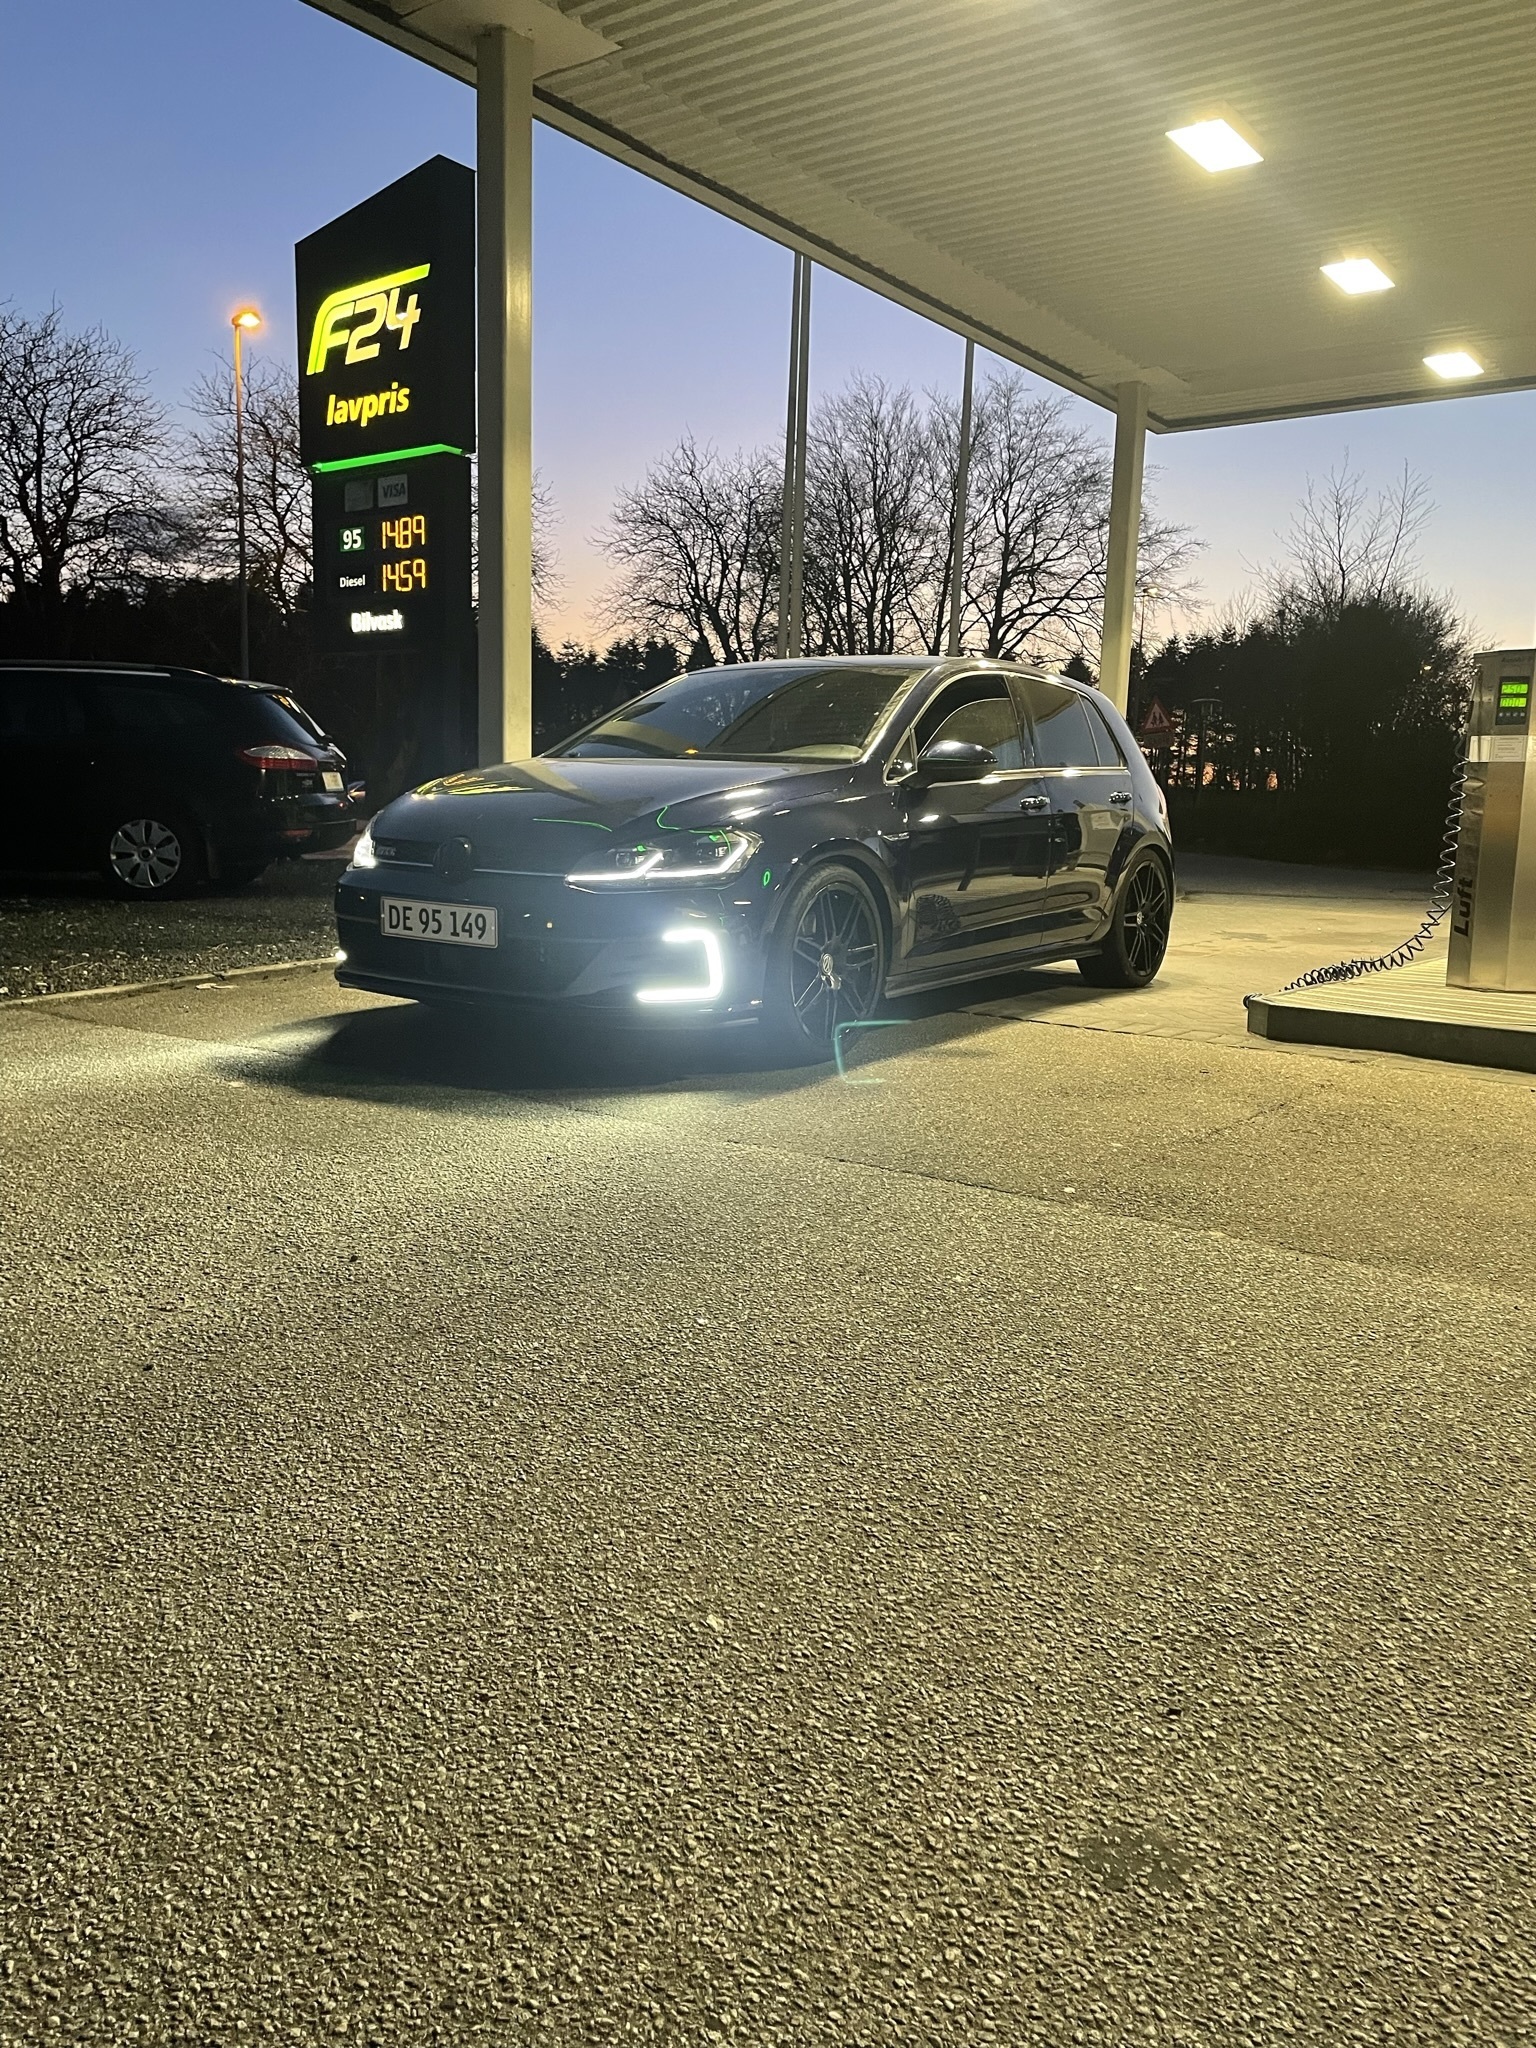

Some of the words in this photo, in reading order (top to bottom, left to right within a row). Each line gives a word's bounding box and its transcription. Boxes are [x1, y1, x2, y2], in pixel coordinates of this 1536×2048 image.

[307, 273, 423, 375] F24
[326, 381, 410, 427] lavpris
[382, 483, 406, 498] VISA
[342, 529, 362, 549] 95
[339, 574, 366, 589] Diesel
[350, 609, 404, 634] Bilvask
[1453, 877, 1473, 937] Luft
[388, 905, 413, 932] DE
[419, 907, 442, 935] 95
[449, 911, 487, 939] 149
